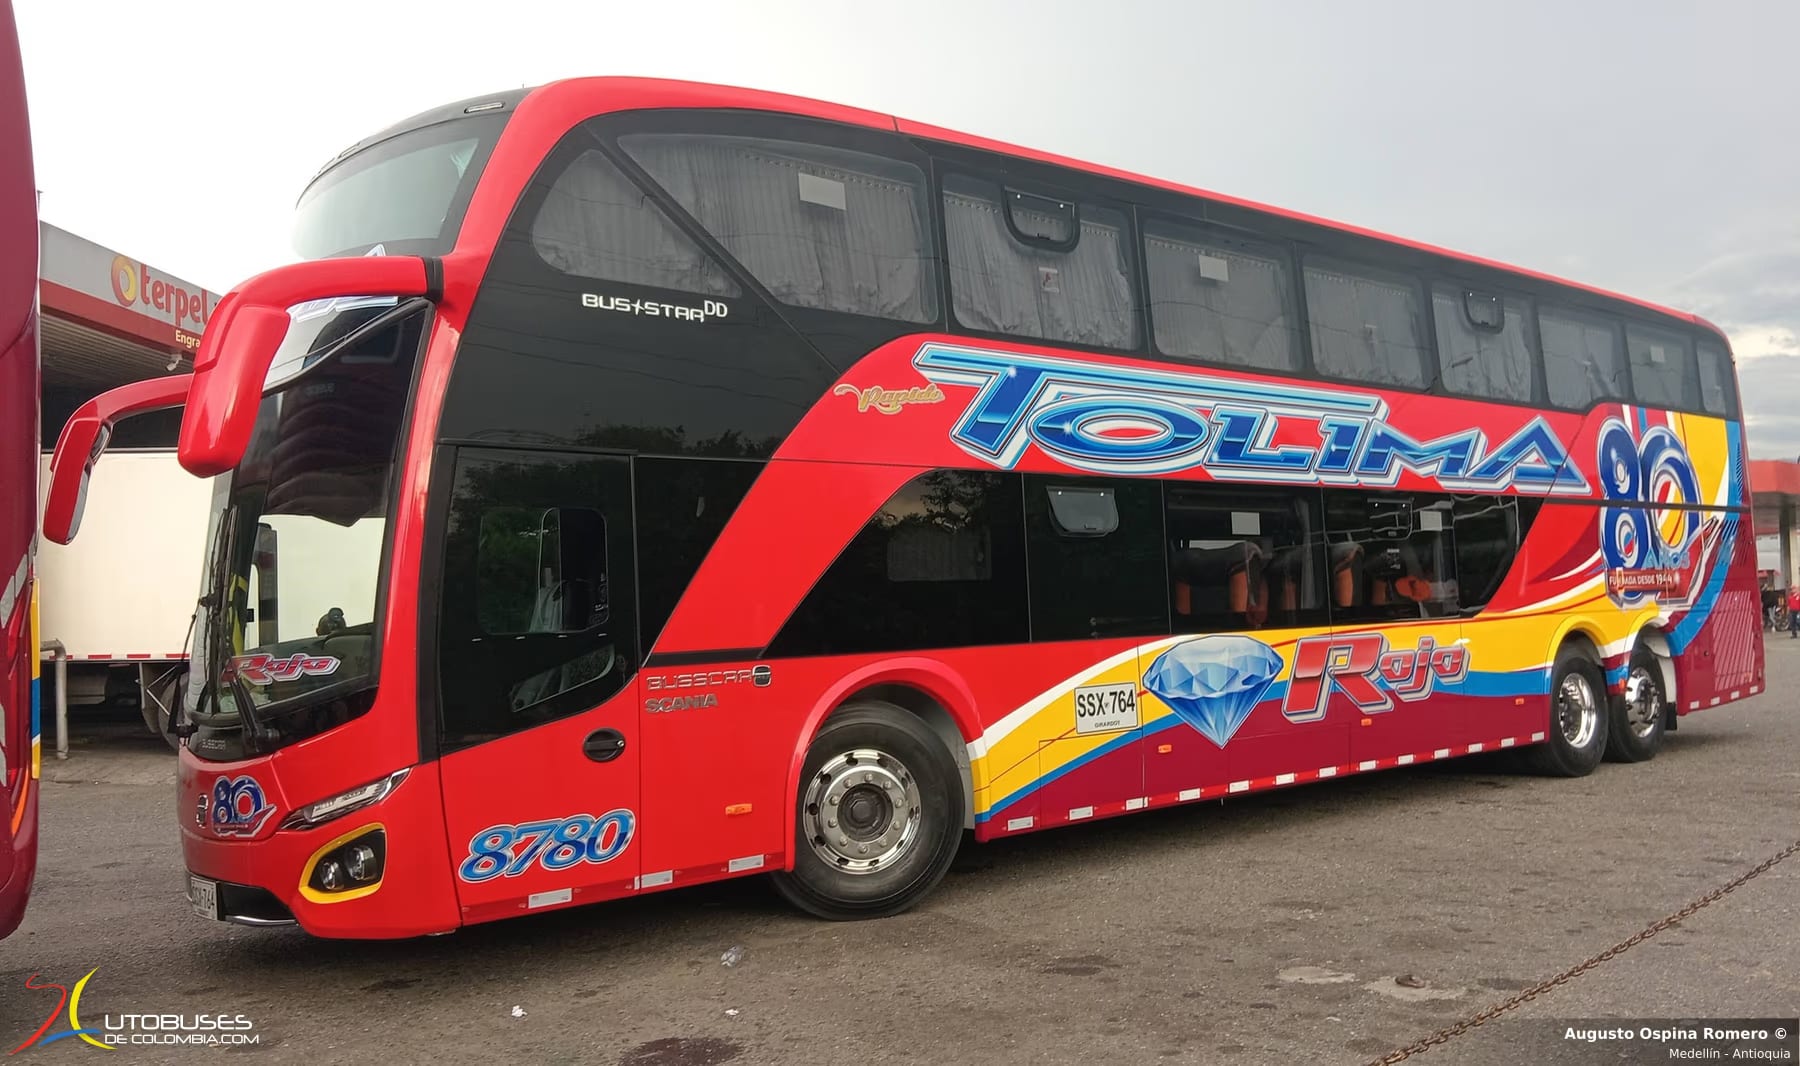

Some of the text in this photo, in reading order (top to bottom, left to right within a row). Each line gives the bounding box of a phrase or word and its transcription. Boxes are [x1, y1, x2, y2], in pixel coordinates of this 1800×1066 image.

[140, 262, 207, 328] terpel
[911, 341, 1592, 497] TOLIMA
[1597, 416, 1704, 602] 80
[645, 693, 718, 713] SCANIA
[647, 669, 752, 690] BUSSCAR
[1282, 633, 1470, 724] Rojo
[1094, 720, 1121, 728] GIRARDOT
[211, 775, 266, 833] 80
[458, 808, 636, 884] 8780
